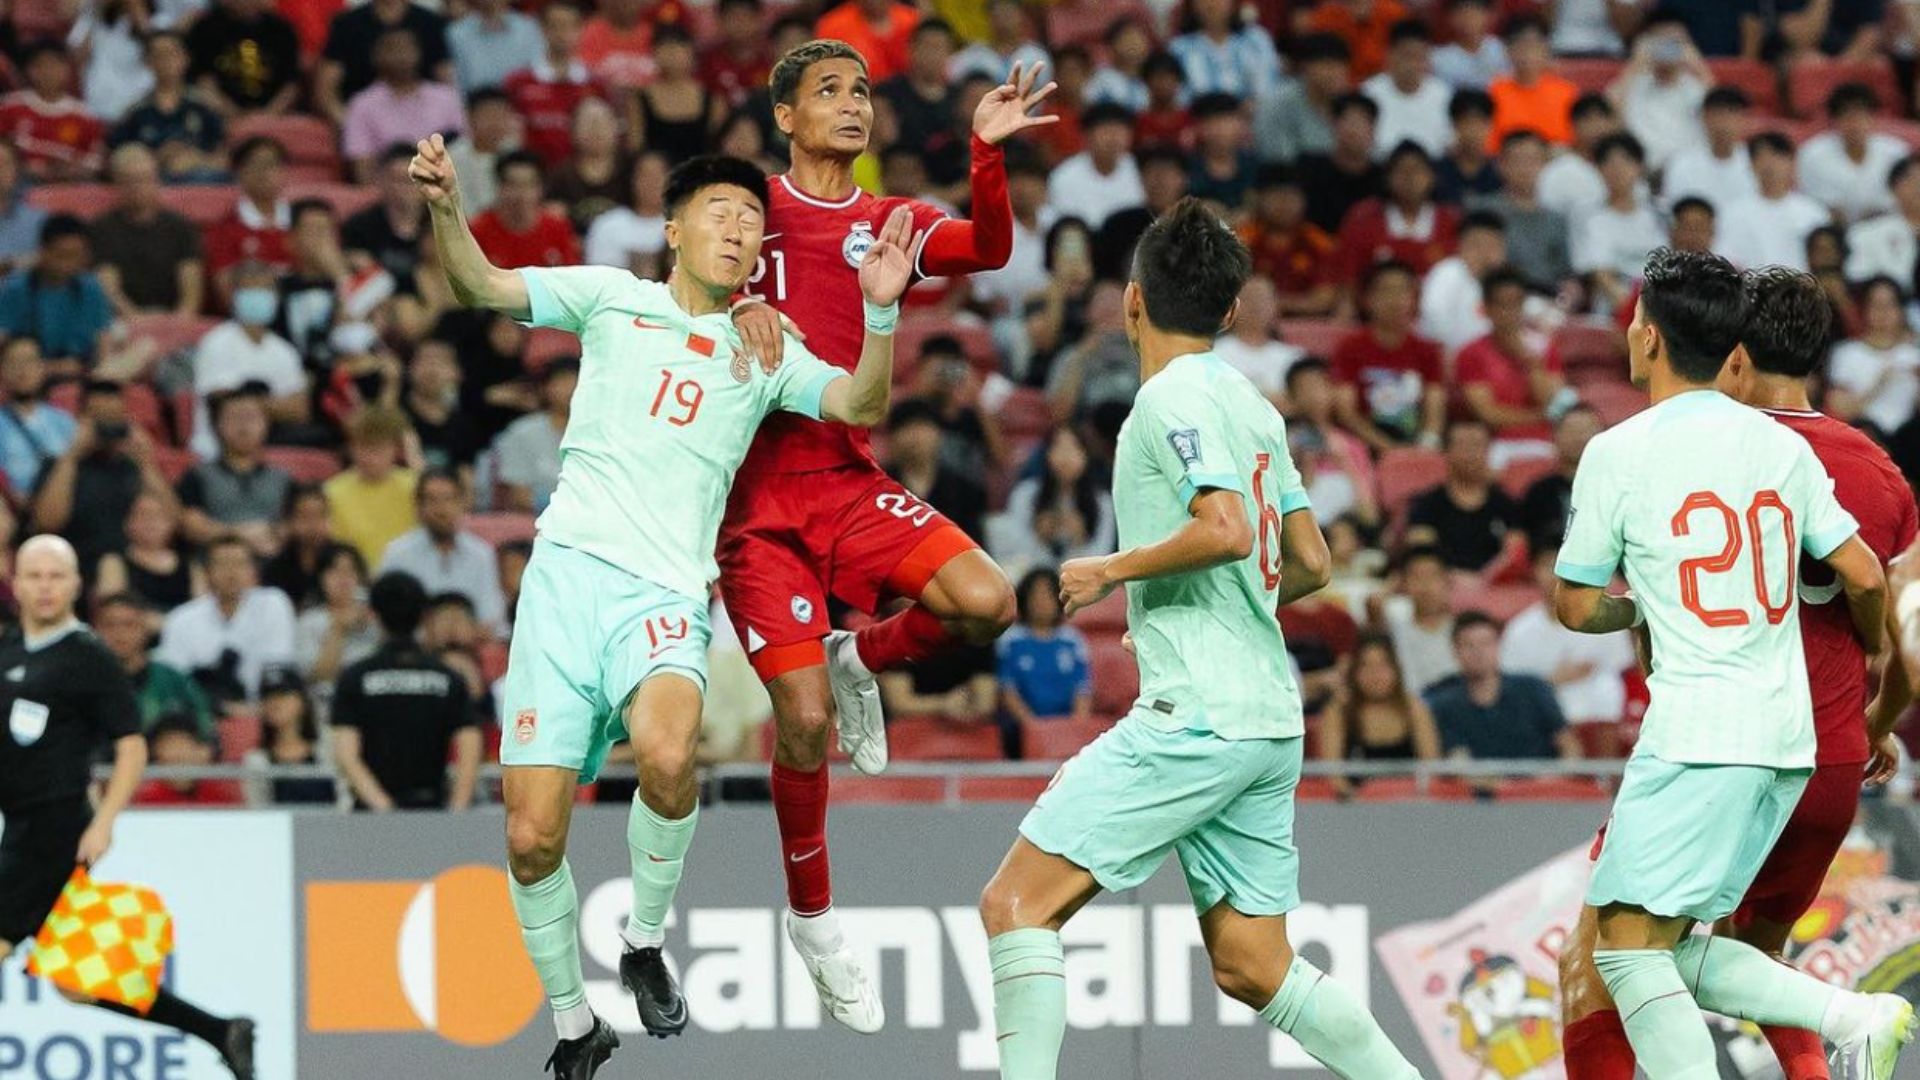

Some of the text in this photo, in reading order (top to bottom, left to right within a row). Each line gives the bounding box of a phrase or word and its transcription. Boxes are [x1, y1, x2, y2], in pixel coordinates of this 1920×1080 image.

[743, 250, 787, 300] 21
[650, 369, 704, 426] 19
[1252, 453, 1282, 591] 6
[1671, 489, 1796, 628] 20
[645, 615, 688, 648] 19
